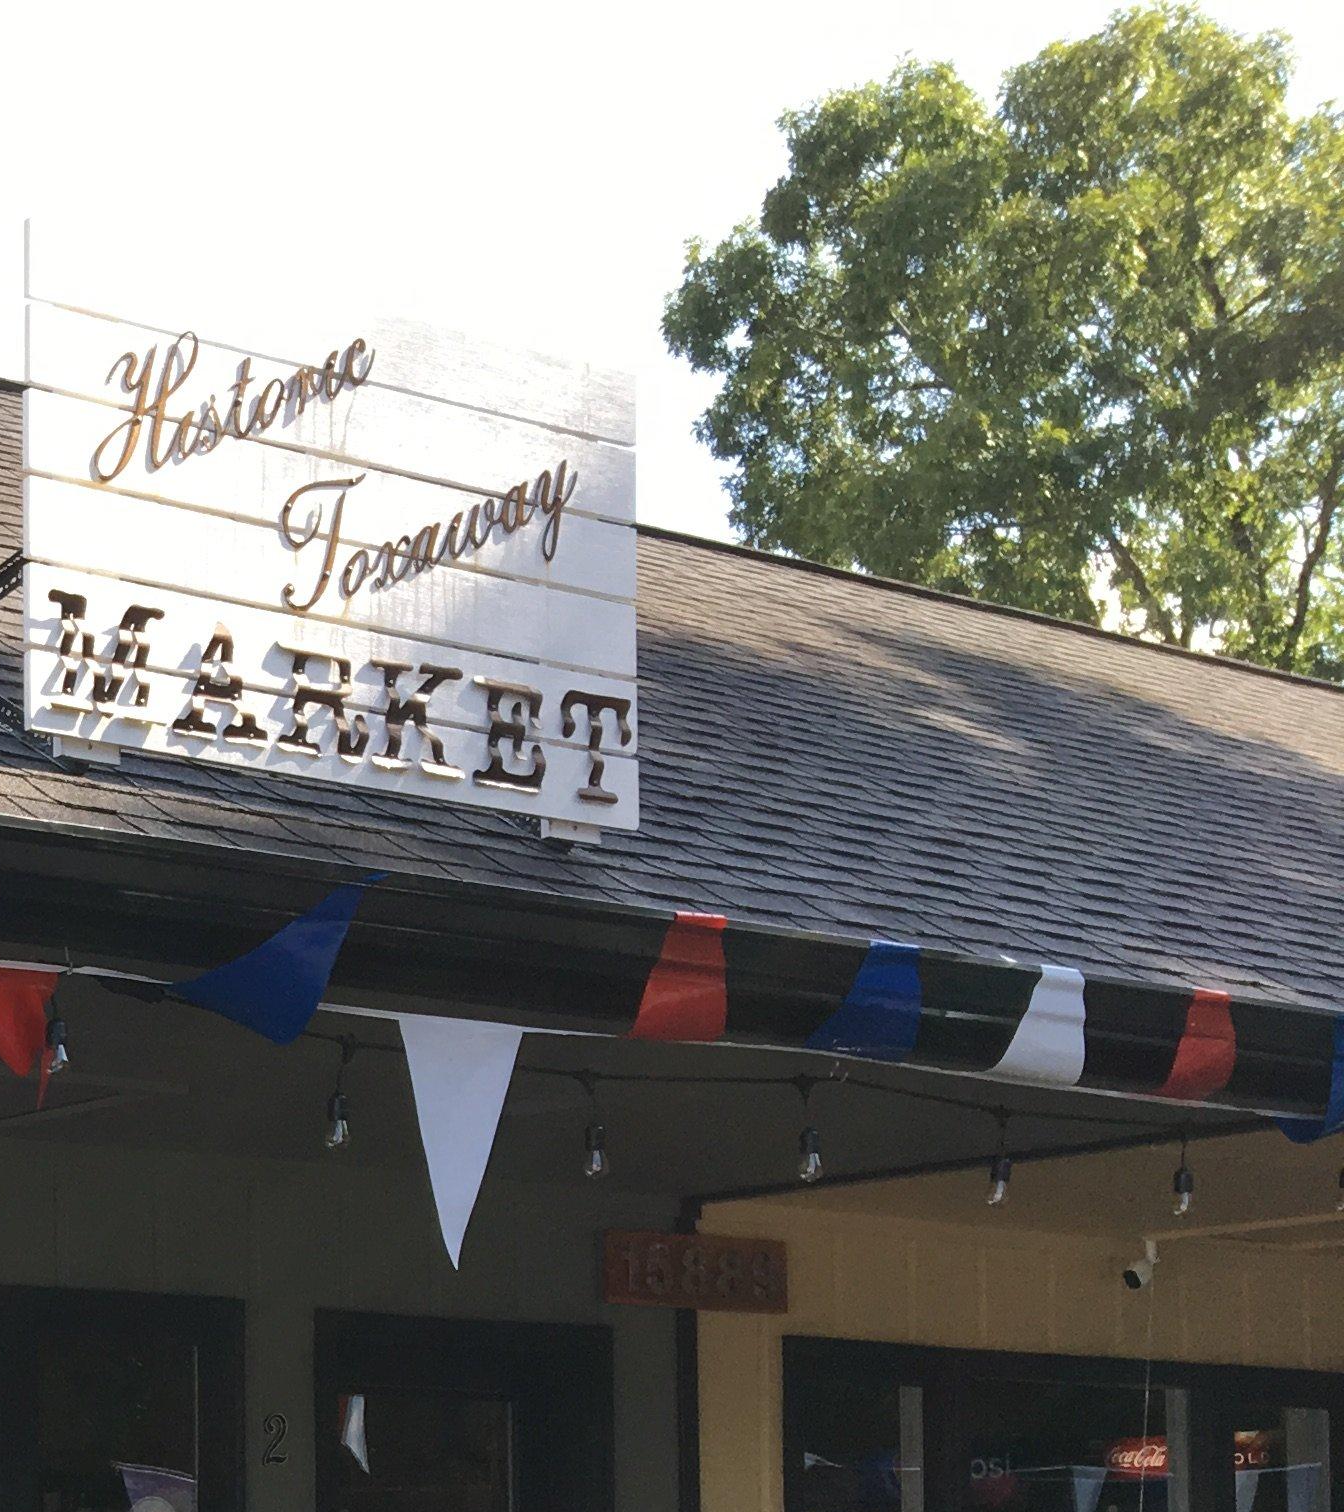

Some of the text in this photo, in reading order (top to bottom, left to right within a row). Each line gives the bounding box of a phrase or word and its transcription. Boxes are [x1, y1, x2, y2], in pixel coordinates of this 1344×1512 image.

[89, 332, 376, 483] Historic
[281, 460, 578, 611] Toxaway
[48, 590, 632, 804] MARKET
[261, 1412, 289, 1467] 2
